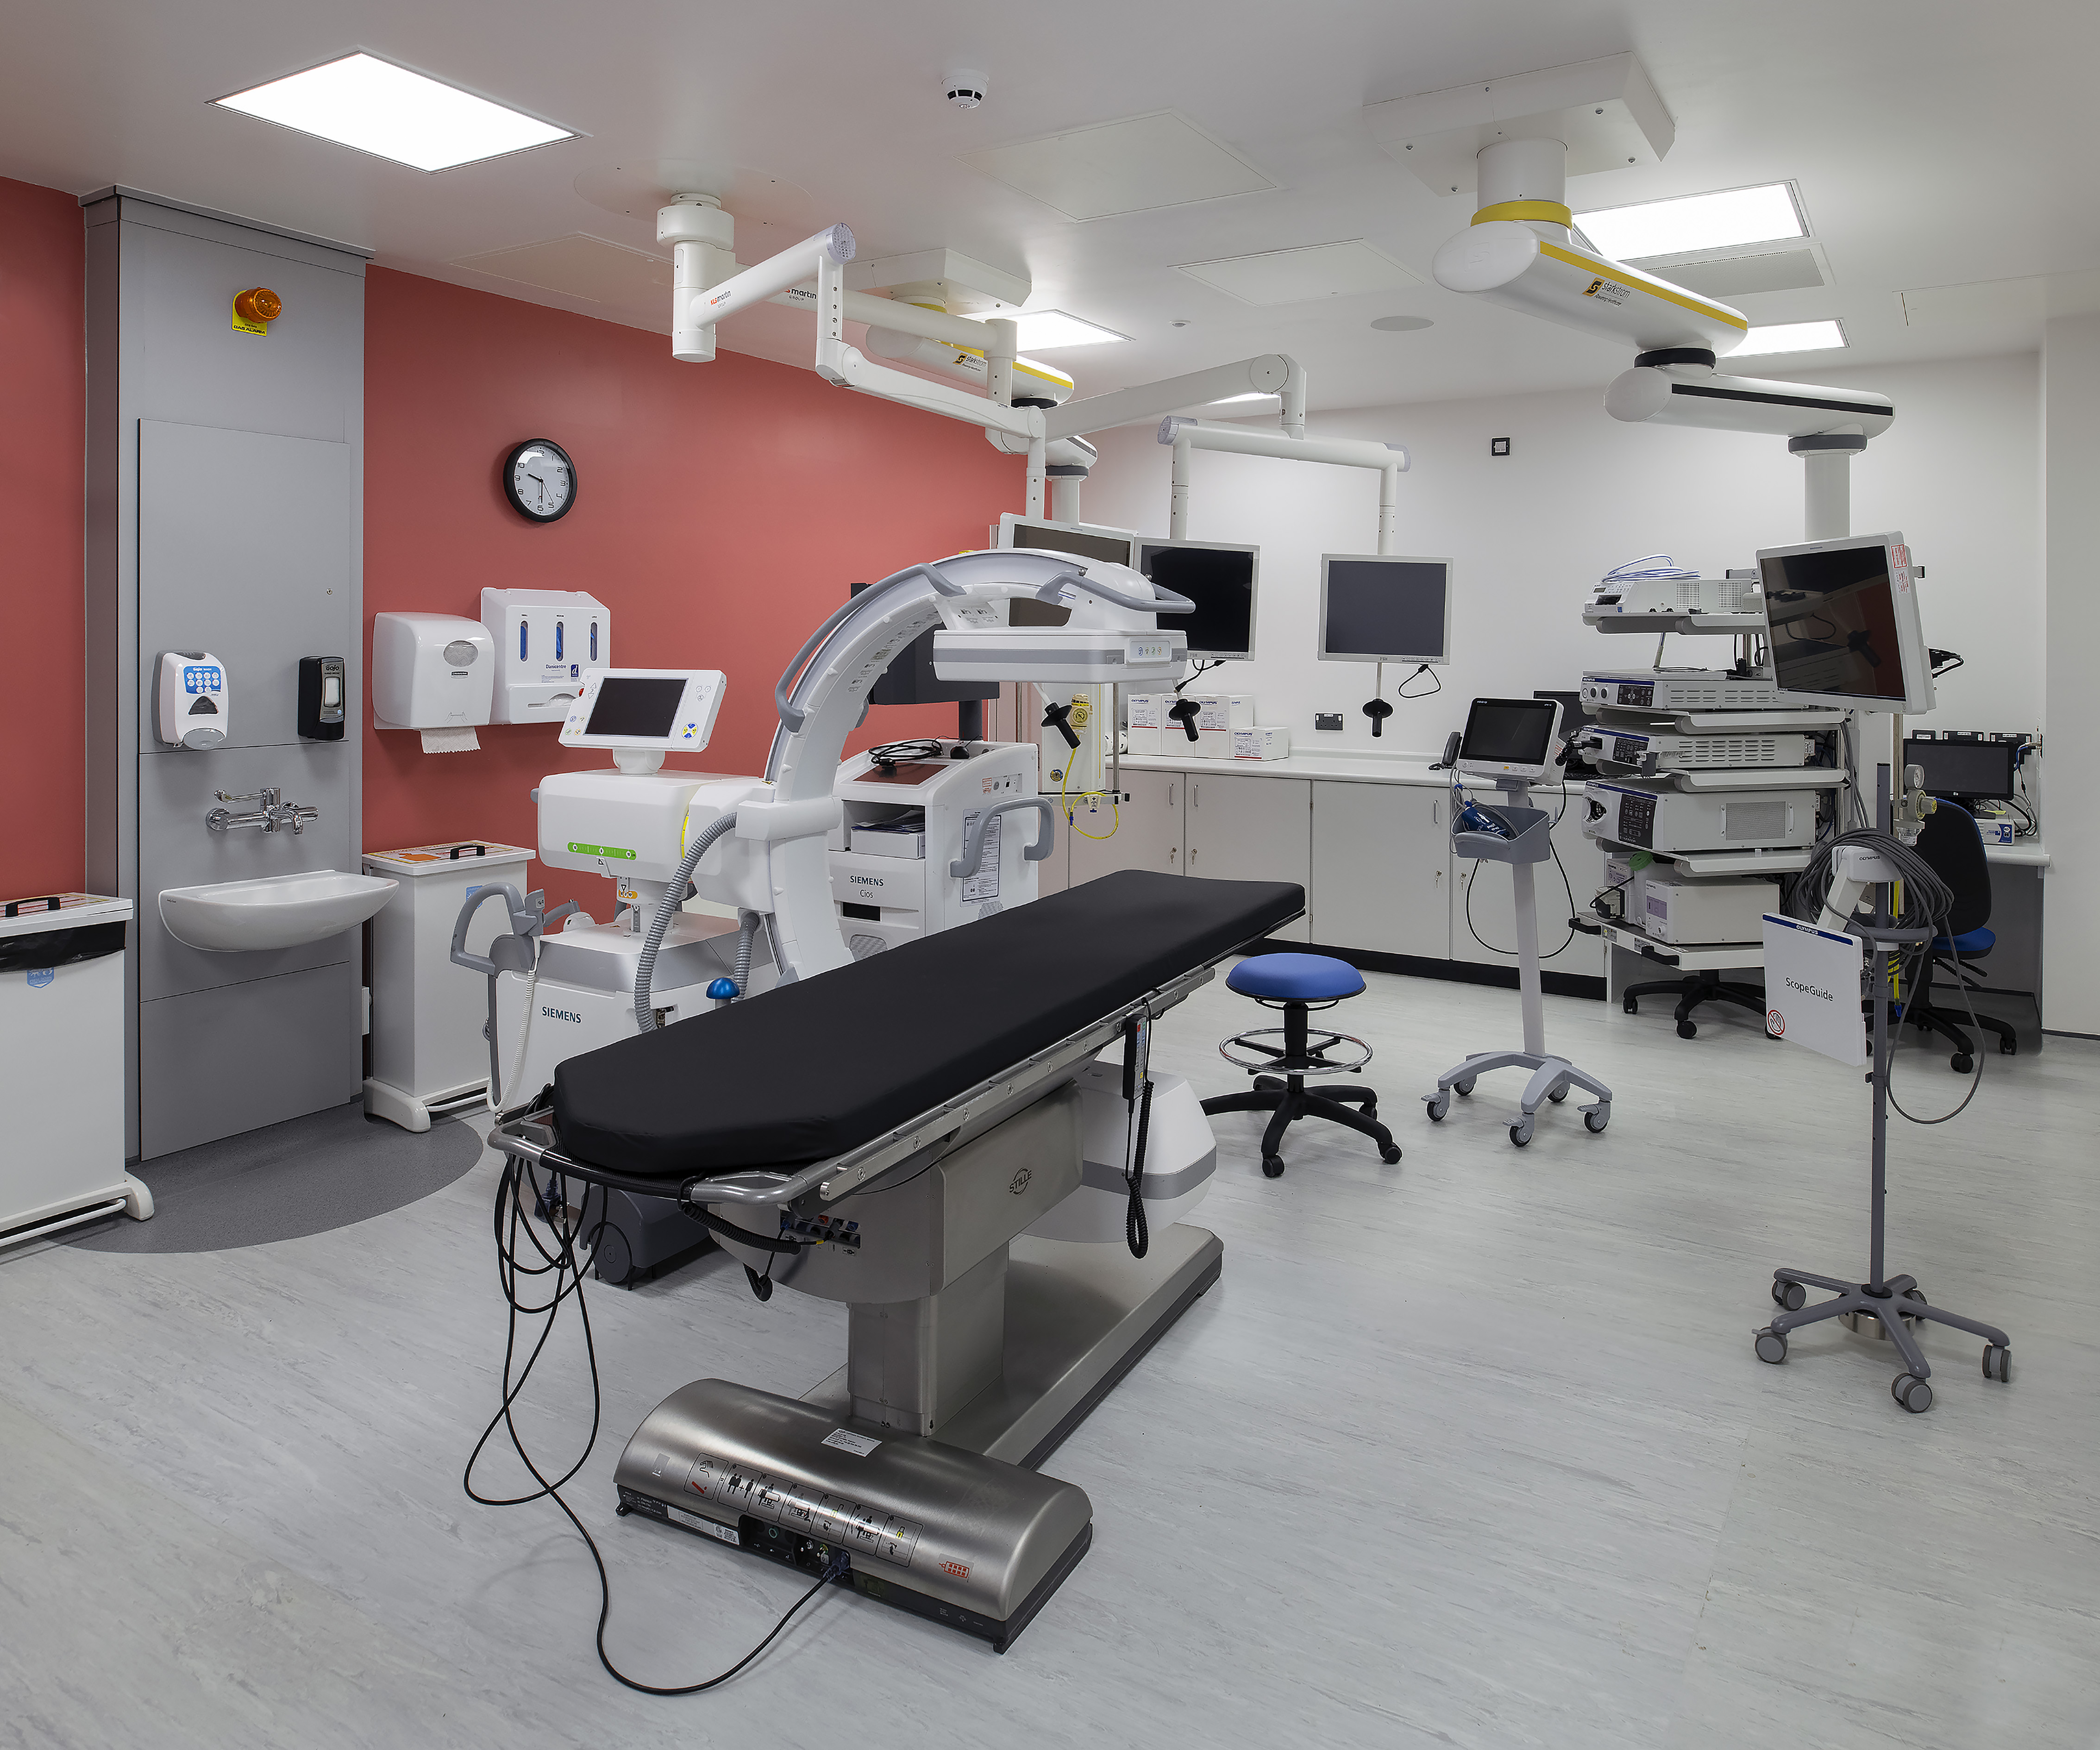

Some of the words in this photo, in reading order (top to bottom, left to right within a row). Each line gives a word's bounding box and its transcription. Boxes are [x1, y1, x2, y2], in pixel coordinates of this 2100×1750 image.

[1602, 282, 1630, 299] starkstrom
[850, 875, 884, 887] SIEMENS
[860, 889, 873, 898] Cios
[1796, 925, 1818, 935] OLYMPUS
[1786, 977, 1833, 1001] ScopeGuide
[542, 1006, 582, 1024] SIEMENS
[1010, 1170, 1032, 1193] STILLE
